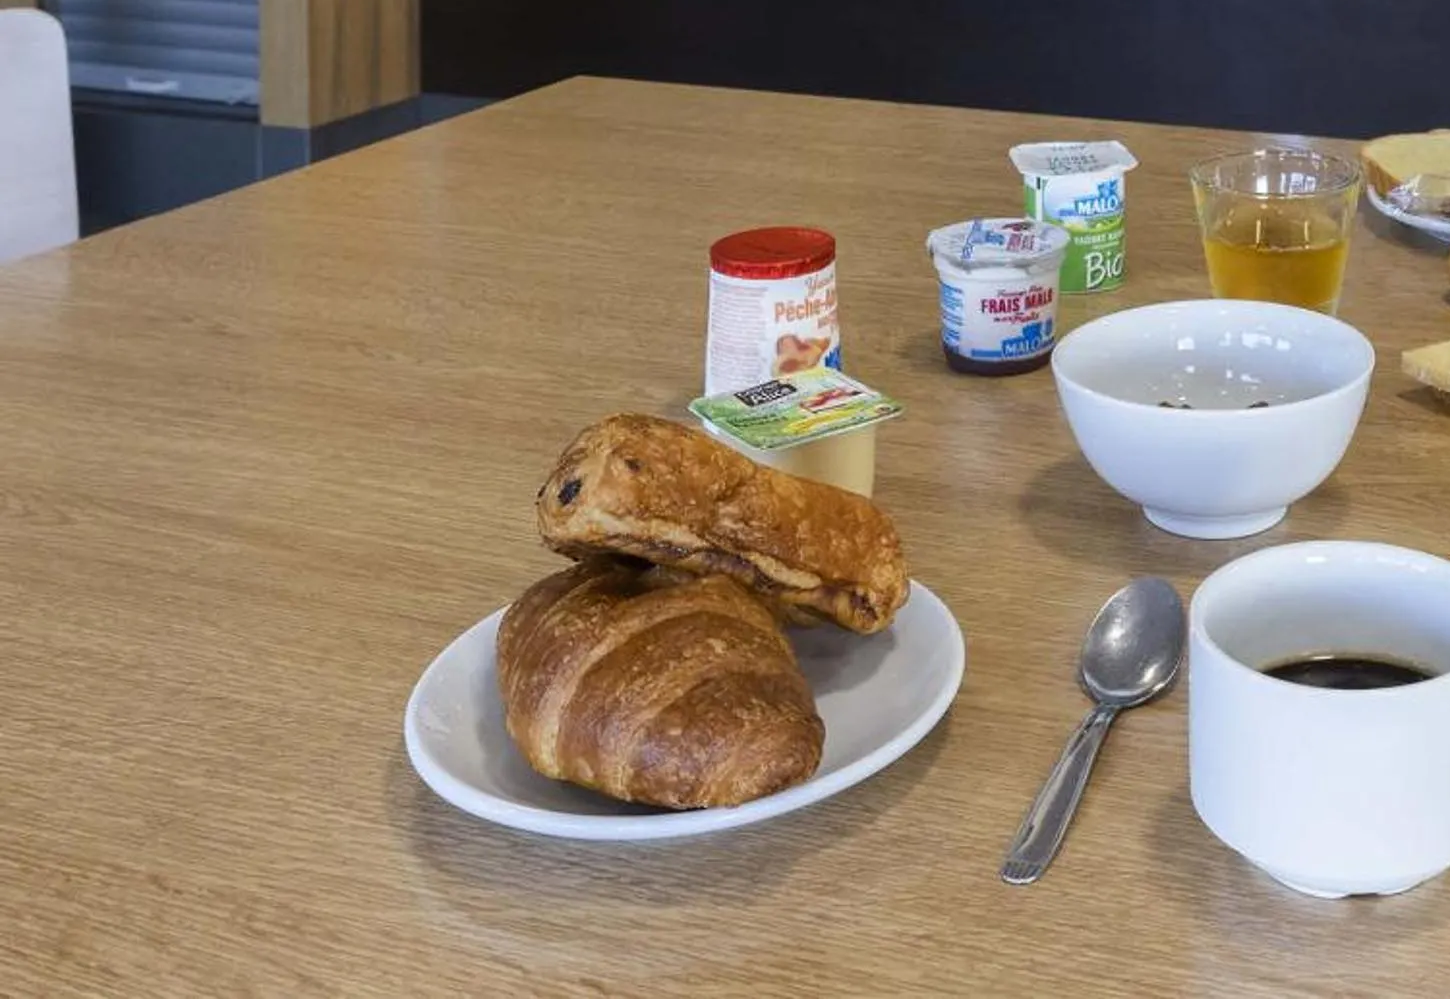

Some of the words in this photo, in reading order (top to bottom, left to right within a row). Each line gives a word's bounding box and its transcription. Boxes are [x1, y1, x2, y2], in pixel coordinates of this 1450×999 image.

[1077, 194, 1119, 216] MALO
[1083, 251, 1123, 290] Bio
[980, 297, 1021, 314] FRAIS
[1004, 338, 1040, 355] MALO
